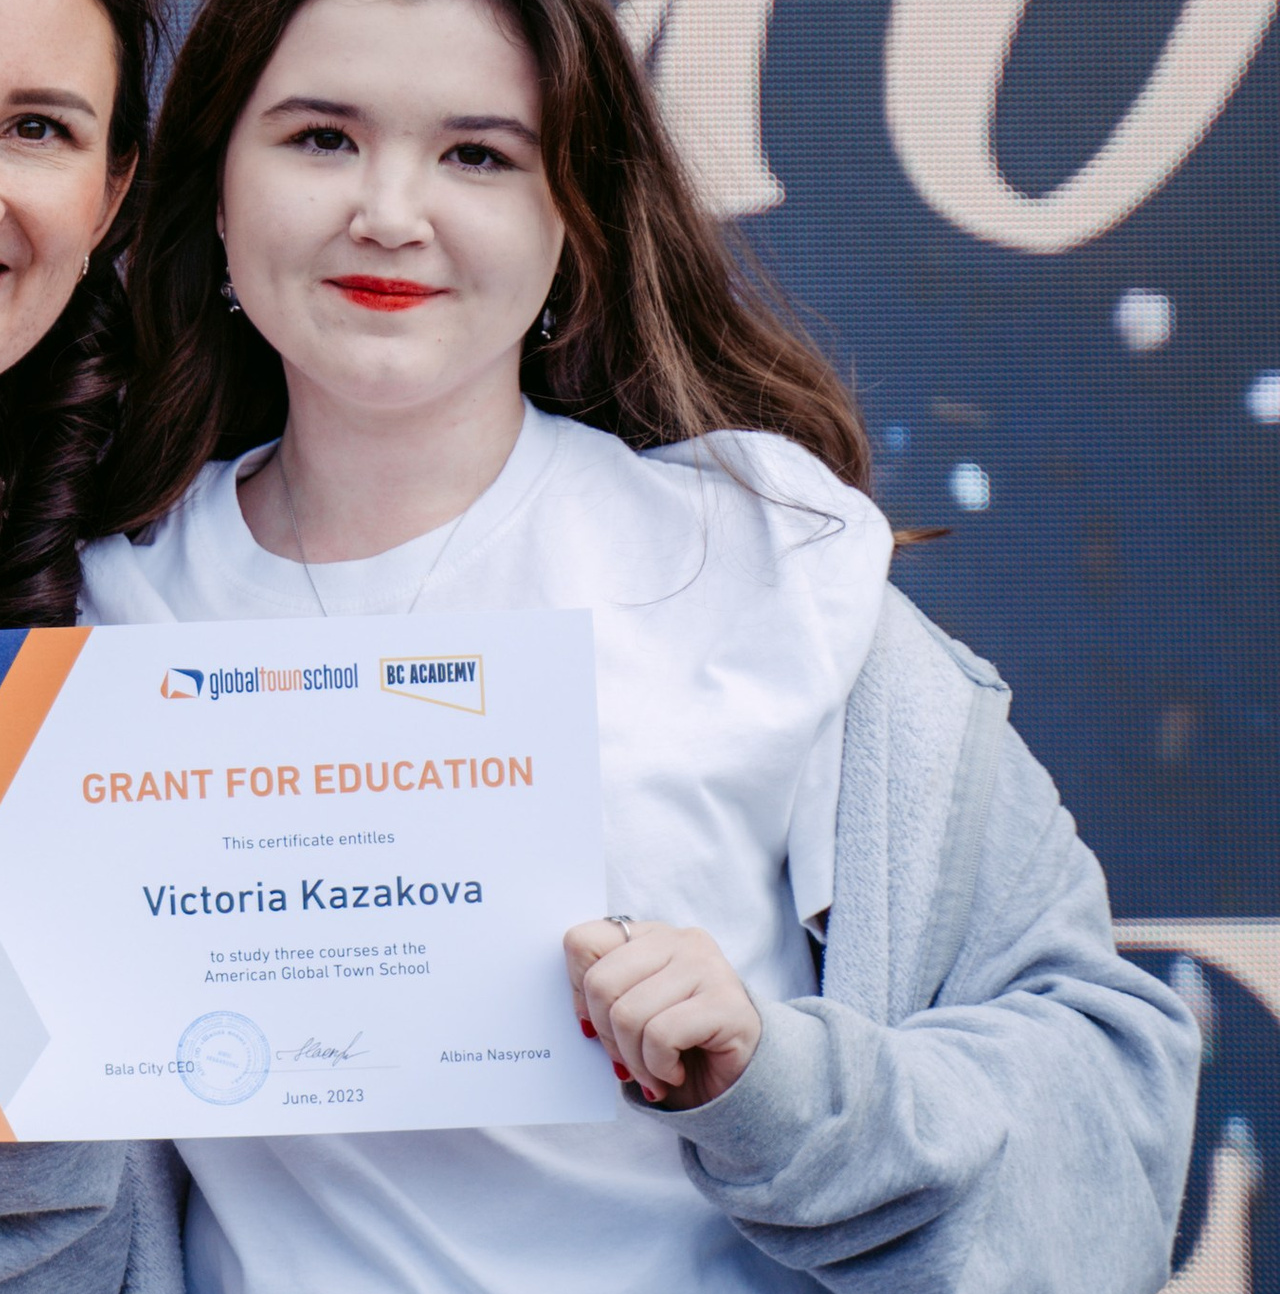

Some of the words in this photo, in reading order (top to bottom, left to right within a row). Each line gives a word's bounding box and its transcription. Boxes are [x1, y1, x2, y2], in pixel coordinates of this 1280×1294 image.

[210, 663, 359, 700] globaltownschool
[386, 664, 406, 685] BC
[409, 661, 477, 684] ACADEMY
[82, 769, 213, 804] GRANT
[226, 765, 301, 798] FOR
[314, 756, 535, 795] EDUCATION
[222, 835, 255, 851] This
[258, 832, 335, 849] certificate
[338, 830, 396, 847] entitles
[143, 881, 287, 916] Victoria
[301, 875, 484, 910] Kazakova
[210, 950, 225, 963] to
[229, 948, 270, 964] study
[274, 946, 315, 961] three
[318, 944, 380, 958] courses
[383, 943, 399, 956] at
[402, 942, 427, 955] the
[204, 968, 277, 983] American
[281, 964, 329, 980] Global
[333, 963, 375, 978] Town
[378, 961, 431, 976] School
[440, 1048, 483, 1063] Albina
[486, 1046, 552, 1063] Nasyrova
[104, 1062, 135, 1076] Bala
[138, 1060, 164, 1077] City
[167, 1059, 195, 1074] CEO
[282, 1091, 322, 1106] June,
[327, 1088, 365, 1104] 2023
